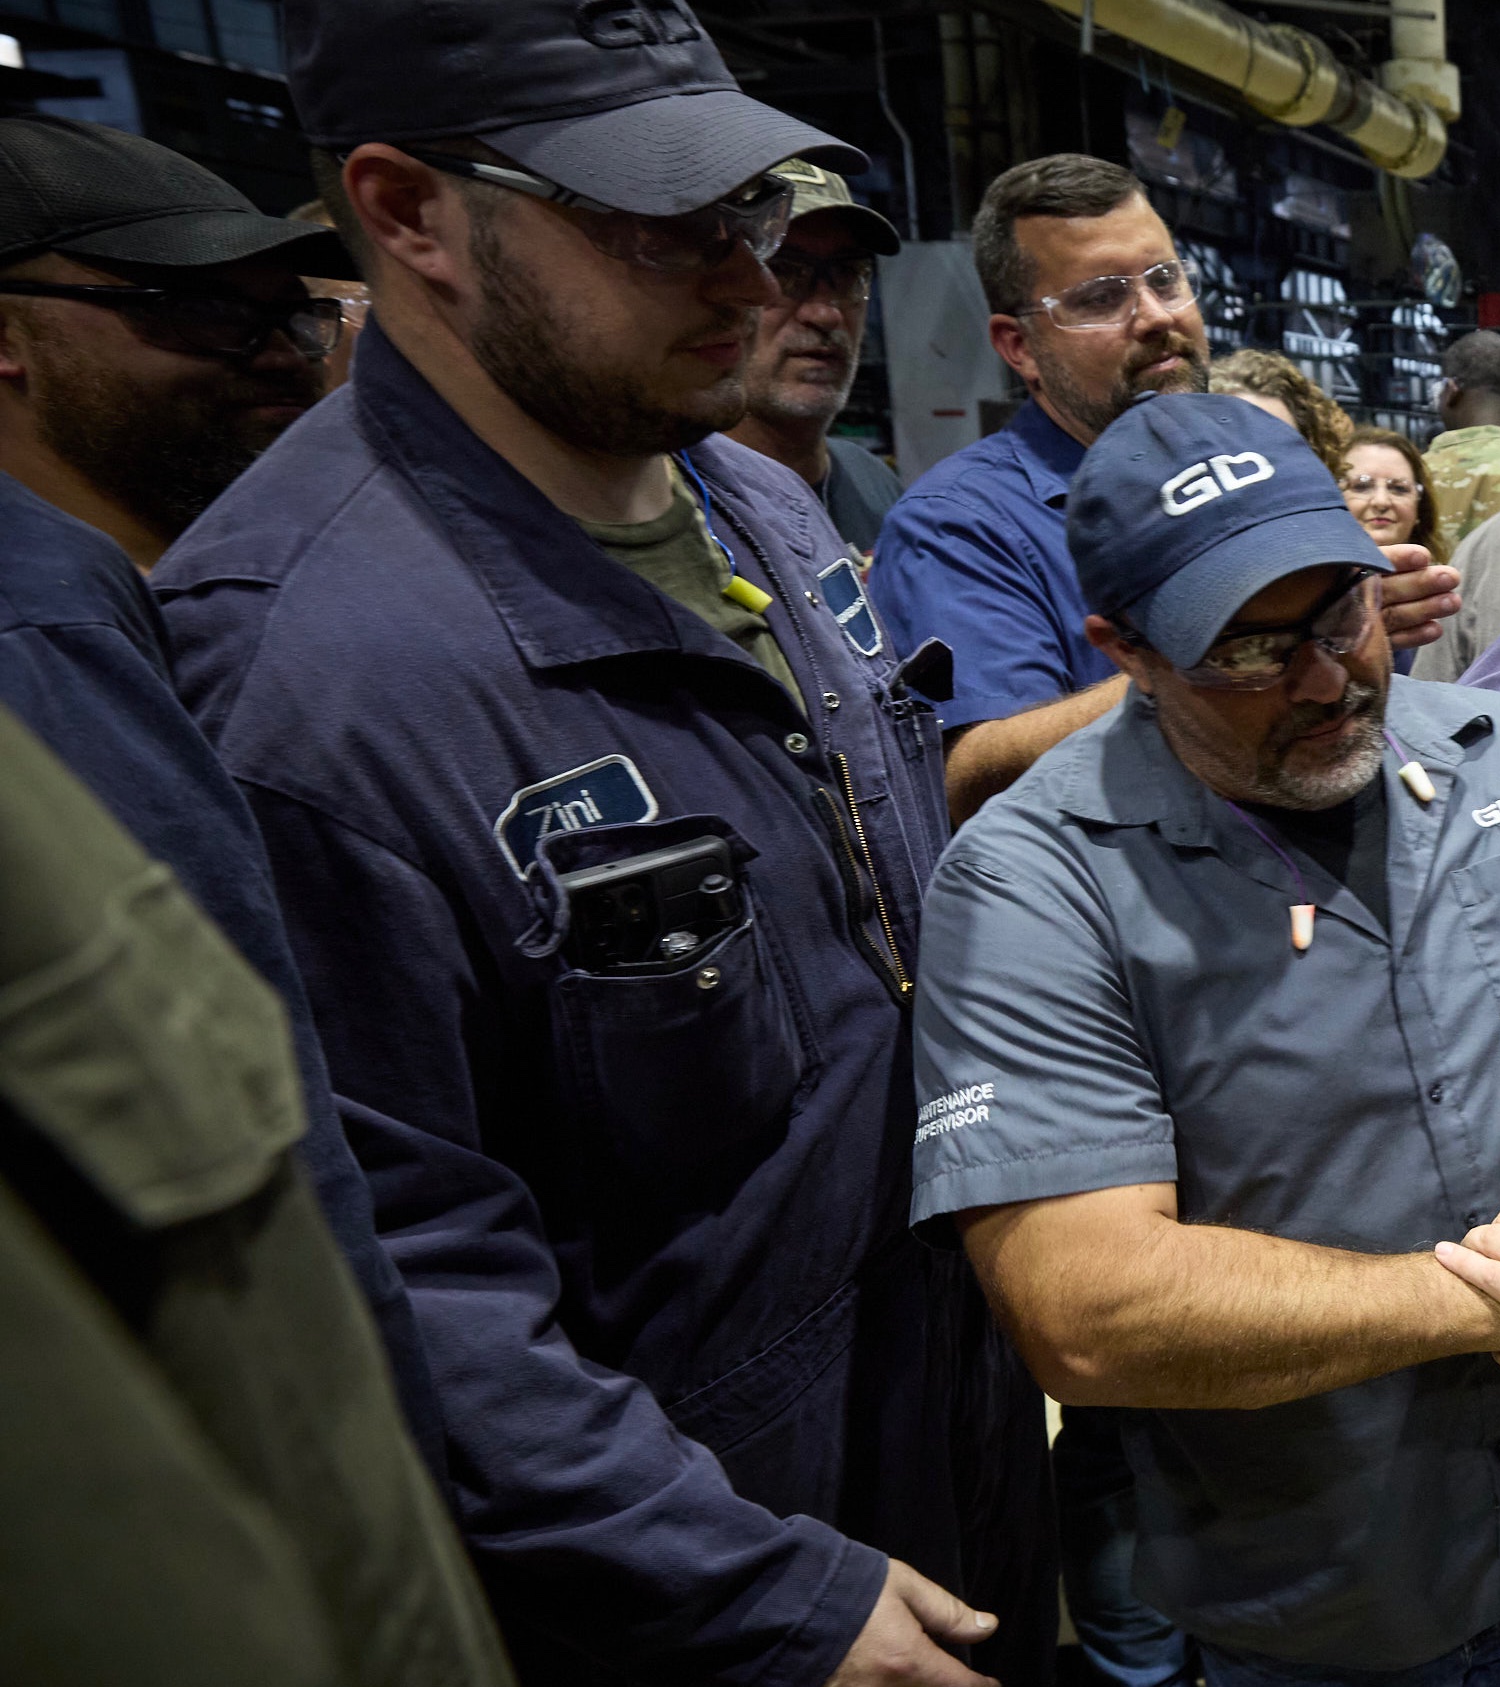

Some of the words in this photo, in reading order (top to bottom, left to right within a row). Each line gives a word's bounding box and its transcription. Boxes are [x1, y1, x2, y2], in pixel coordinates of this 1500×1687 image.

[1160, 451, 1276, 517] GD
[524, 789, 604, 839] Zini
[918, 1082, 995, 1124] AINTENANCE
